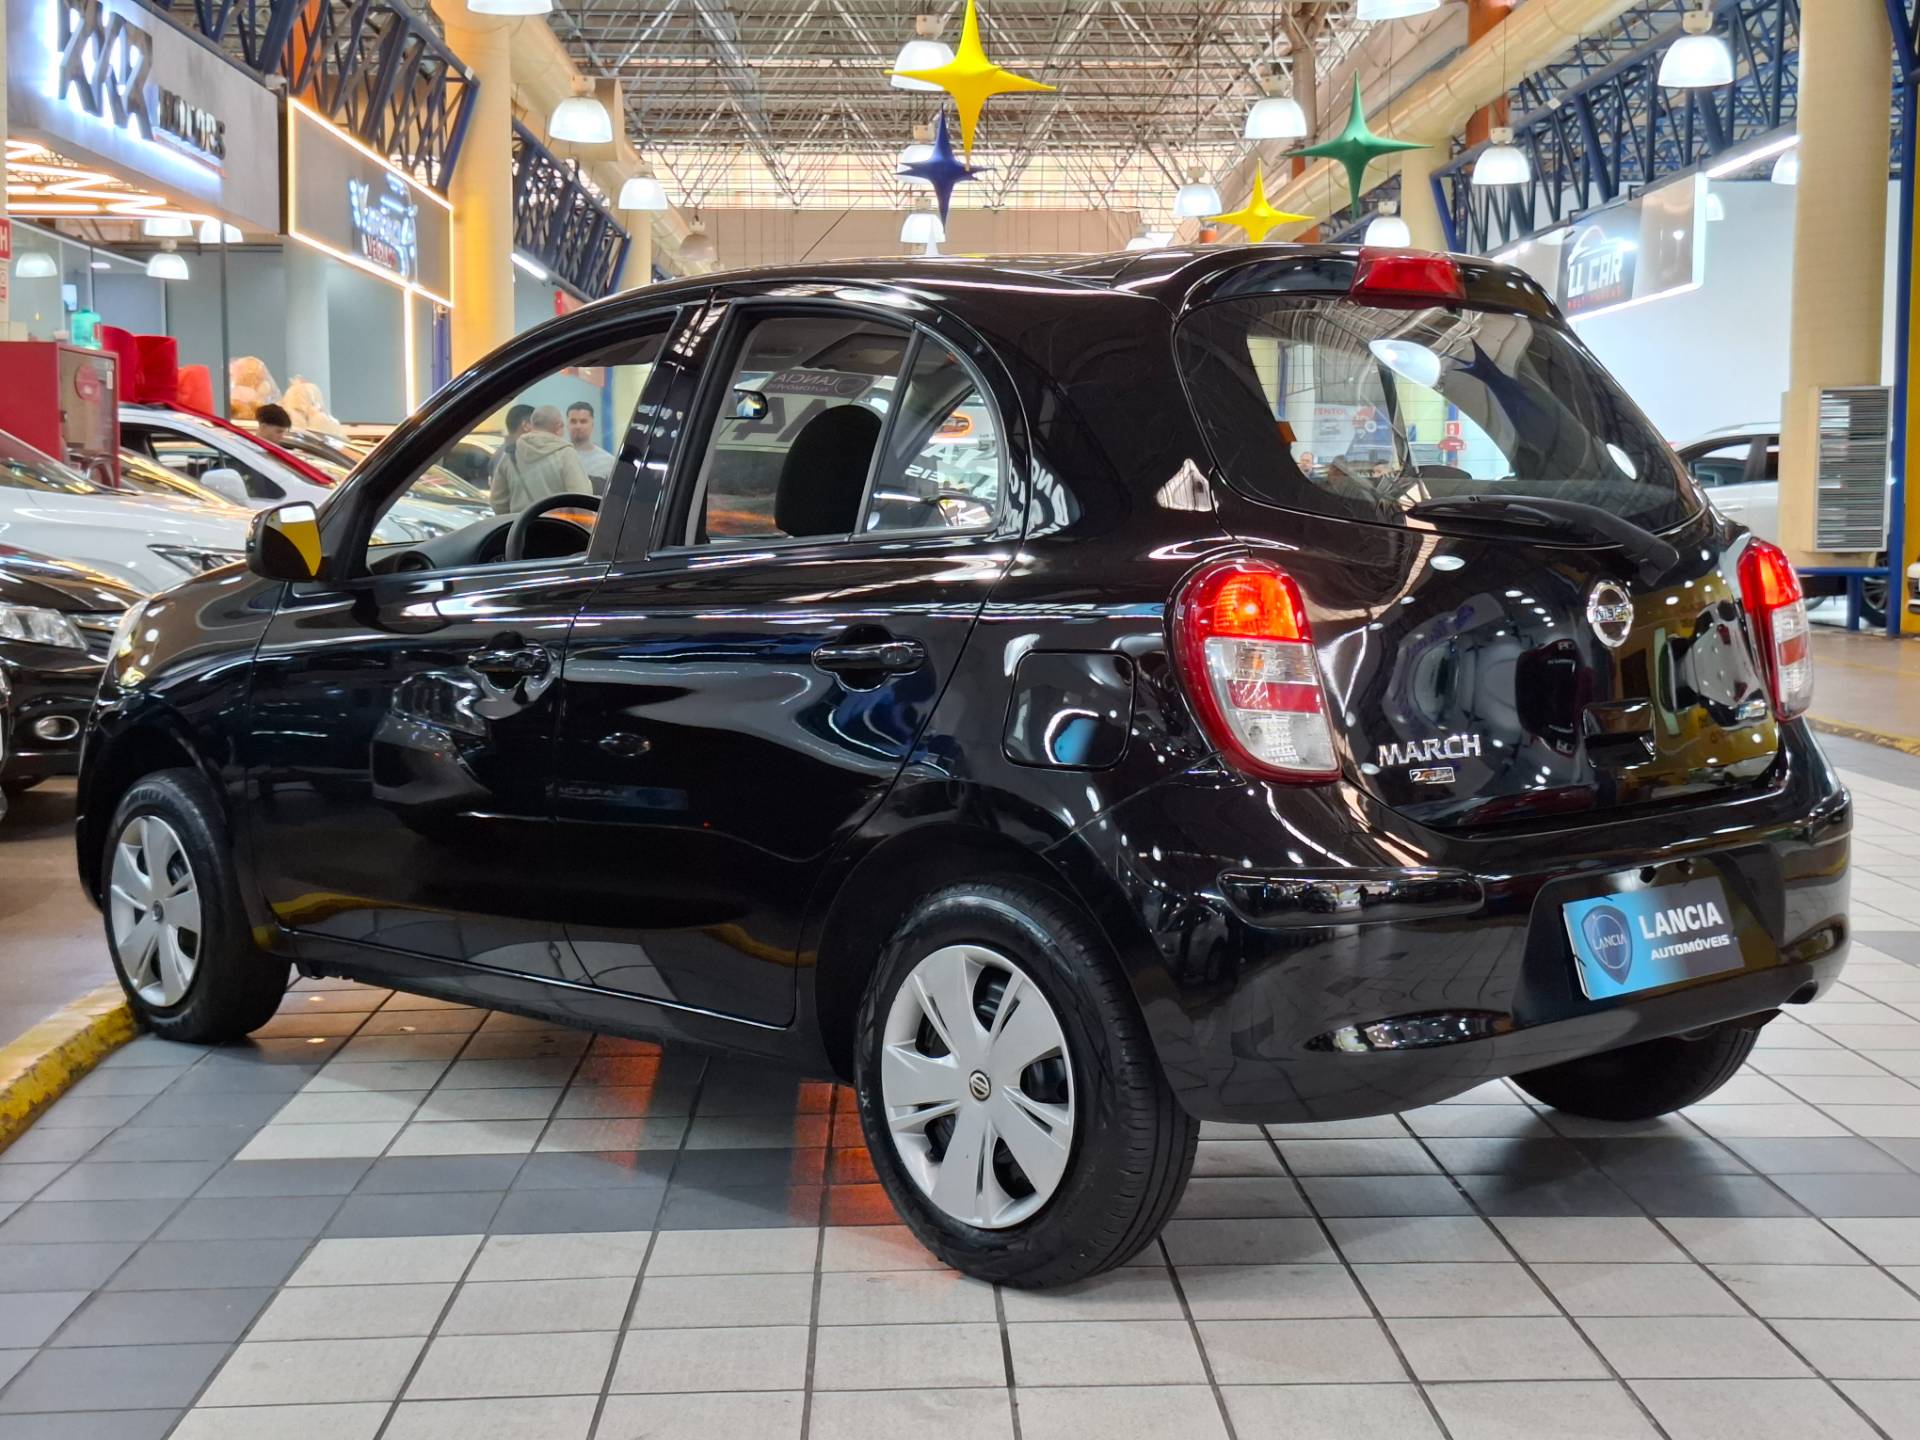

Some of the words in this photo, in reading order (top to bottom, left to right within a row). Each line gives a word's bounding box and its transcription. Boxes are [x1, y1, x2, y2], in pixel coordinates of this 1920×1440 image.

[1587, 250, 1623, 292] CAR
[1378, 733, 1481, 767] MARCH
[1638, 901, 1724, 940] LANCIA
[1591, 933, 1628, 951] LANCIA
[1650, 933, 1731, 961] AUTOMÓVEIS
